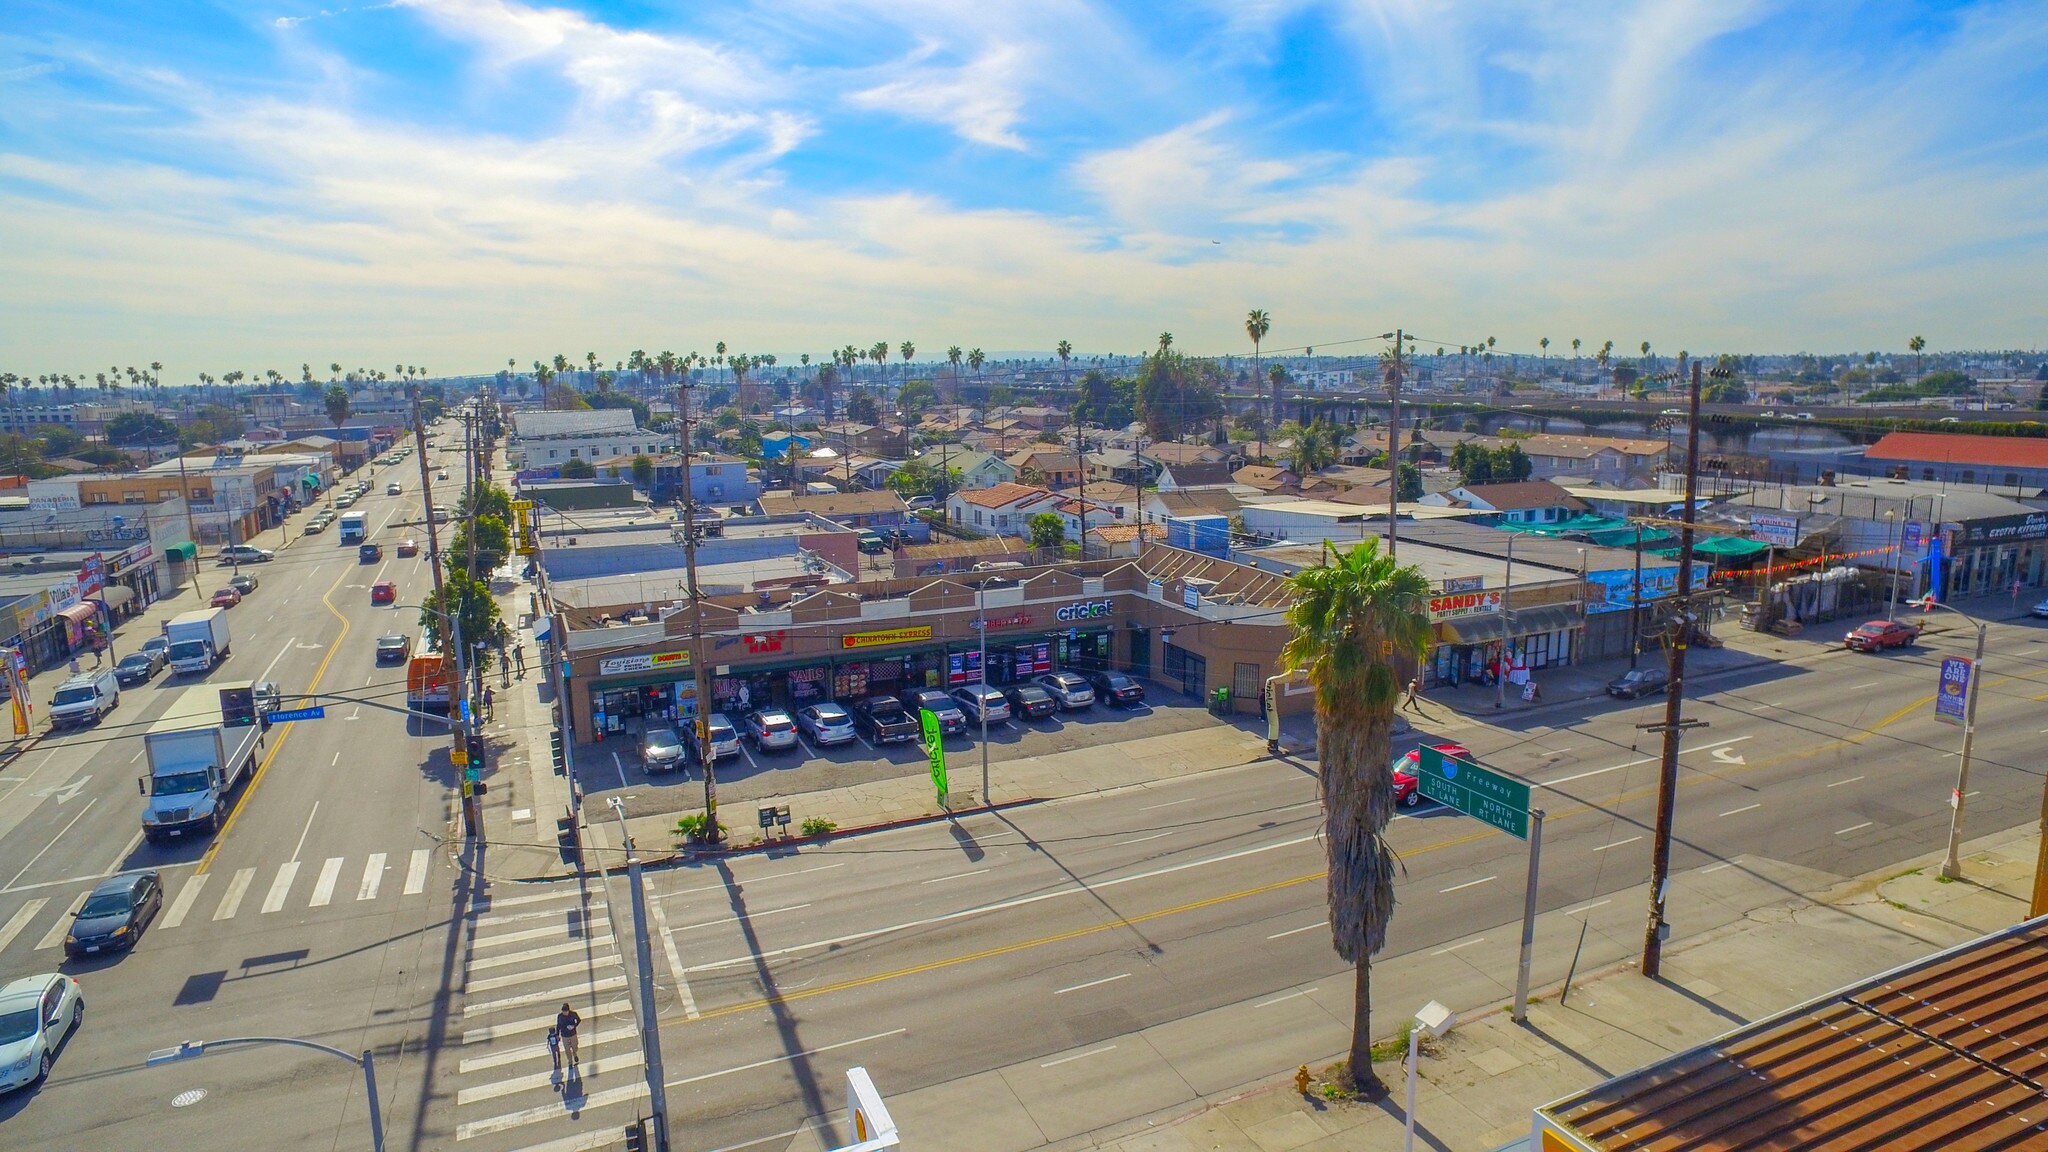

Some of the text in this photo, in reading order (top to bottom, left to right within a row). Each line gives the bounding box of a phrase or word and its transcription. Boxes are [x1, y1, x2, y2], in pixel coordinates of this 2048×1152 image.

[1756, 518, 1792, 527] CABINETS
[1749, 532, 1788, 544] CERAMIC TILE
[1989, 526, 2016, 538] EXOTIC
[50, 586, 71, 604] Villa's
[1430, 591, 1500, 612] SANDY'S
[1056, 600, 1113, 622] cricket
[1437, 610, 1451, 618] PARTY
[1452, 607, 1468, 616] SUPPLY
[1474, 604, 1493, 613] RENTALS
[856, 629, 931, 644] CHINATOWN EXPRESS
[657, 653, 681, 662] DONUTS
[1949, 660, 1965, 669] WE
[789, 667, 825, 683] NAILS
[1944, 673, 1966, 684] ONE
[1946, 666, 1966, 676] ARE
[713, 678, 738, 695] NAILS
[272, 711, 308, 720] Florence
[1431, 778, 1457, 795] SOUTH
[1466, 771, 1512, 798] Freeway
[1427, 786, 1460, 807] LT LANE
[1483, 799, 1512, 819] NORTH
[1479, 808, 1516, 831] RT LANE
